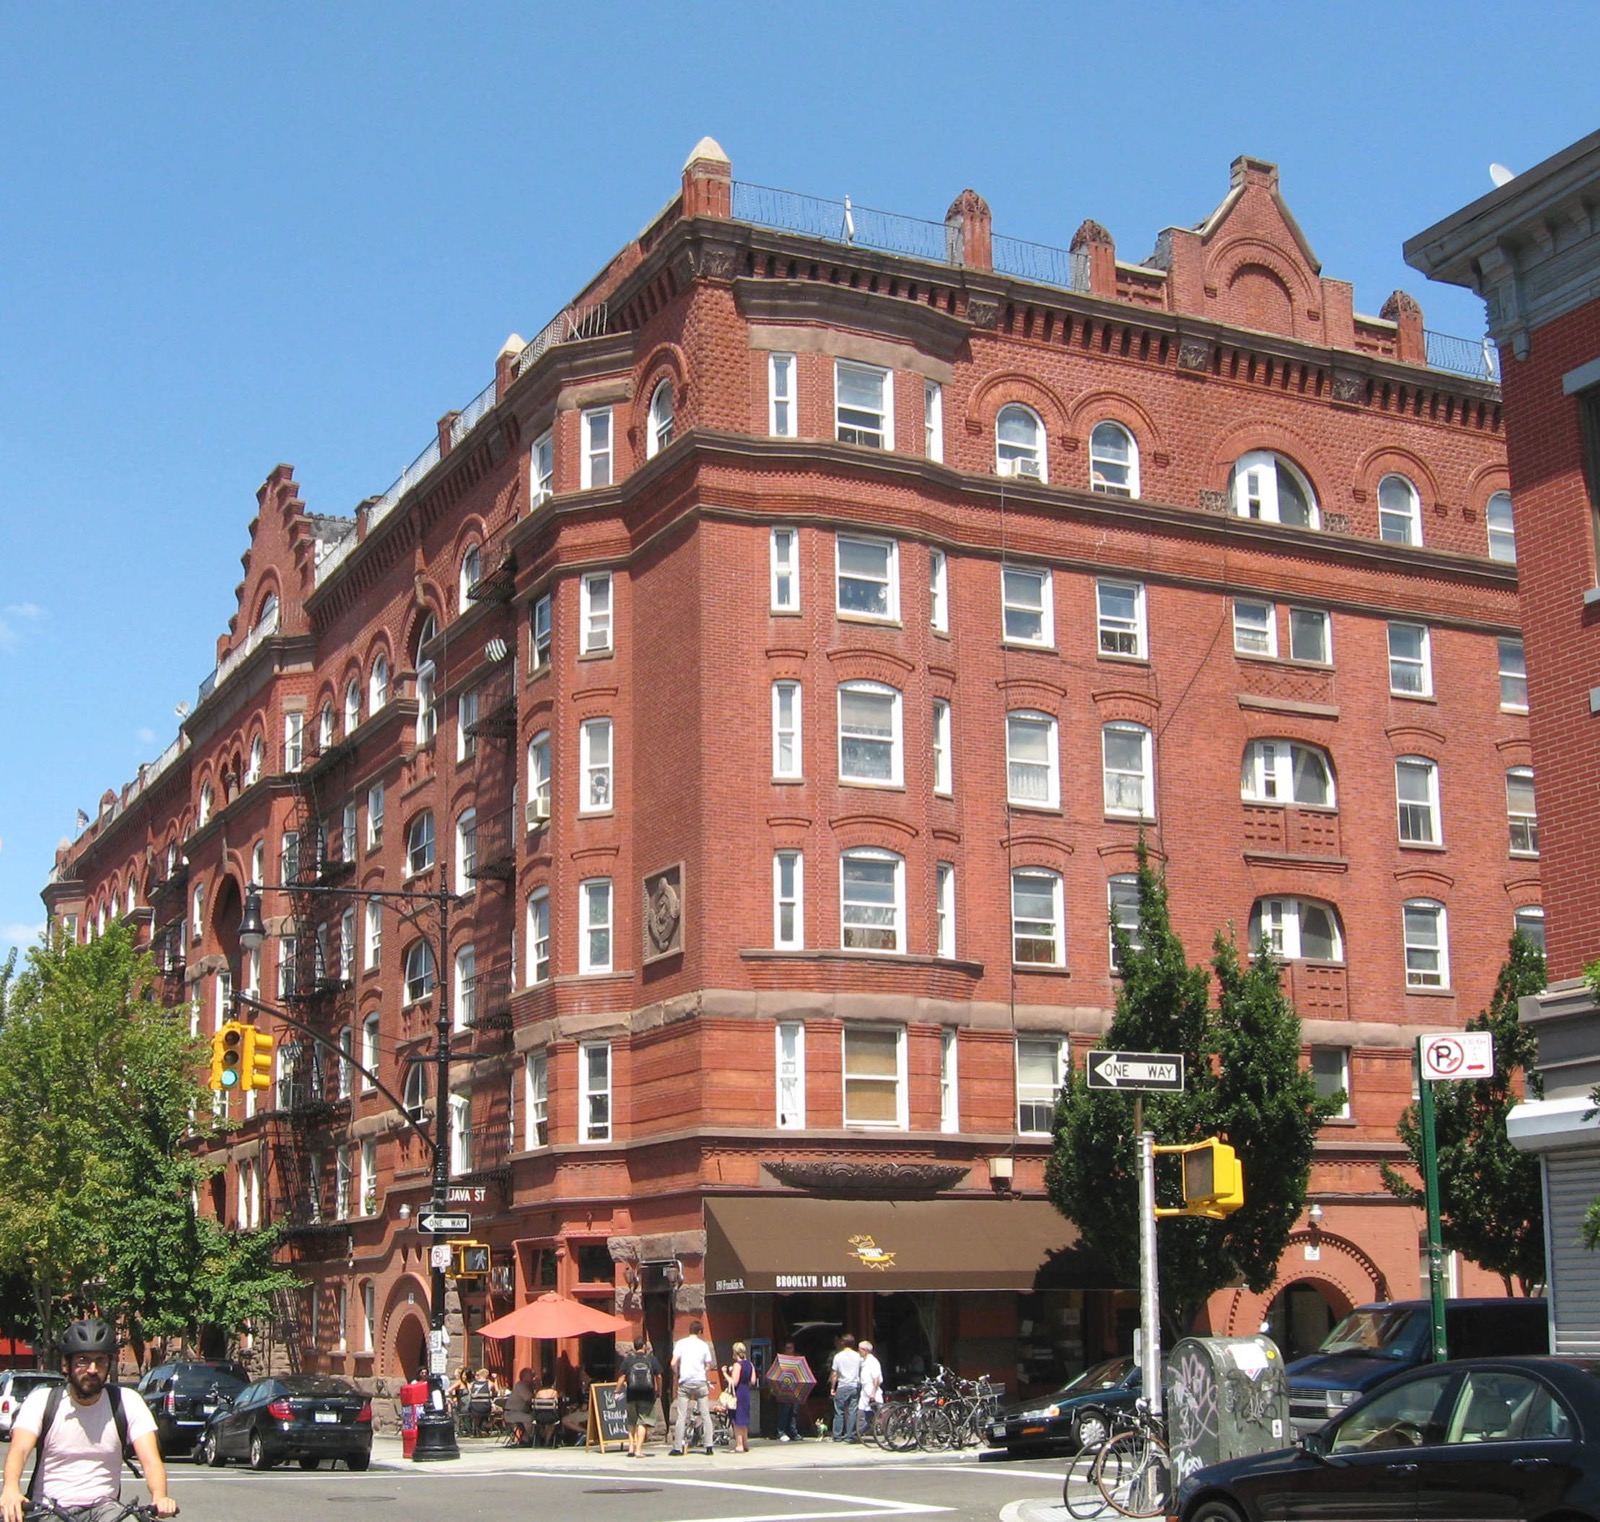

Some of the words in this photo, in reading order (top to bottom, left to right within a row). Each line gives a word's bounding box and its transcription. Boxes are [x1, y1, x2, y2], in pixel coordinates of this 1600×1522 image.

[1104, 1063, 1129, 1078] ONE
[1147, 1065, 1174, 1079] WAY
[449, 1189, 471, 1202] JAVA
[474, 1189, 486, 1202] ST
[428, 1219, 443, 1227] ONE
[450, 1219, 465, 1227] WAY
[775, 1275, 818, 1288] BROOKLYN
[821, 1275, 847, 1288] LABEL
